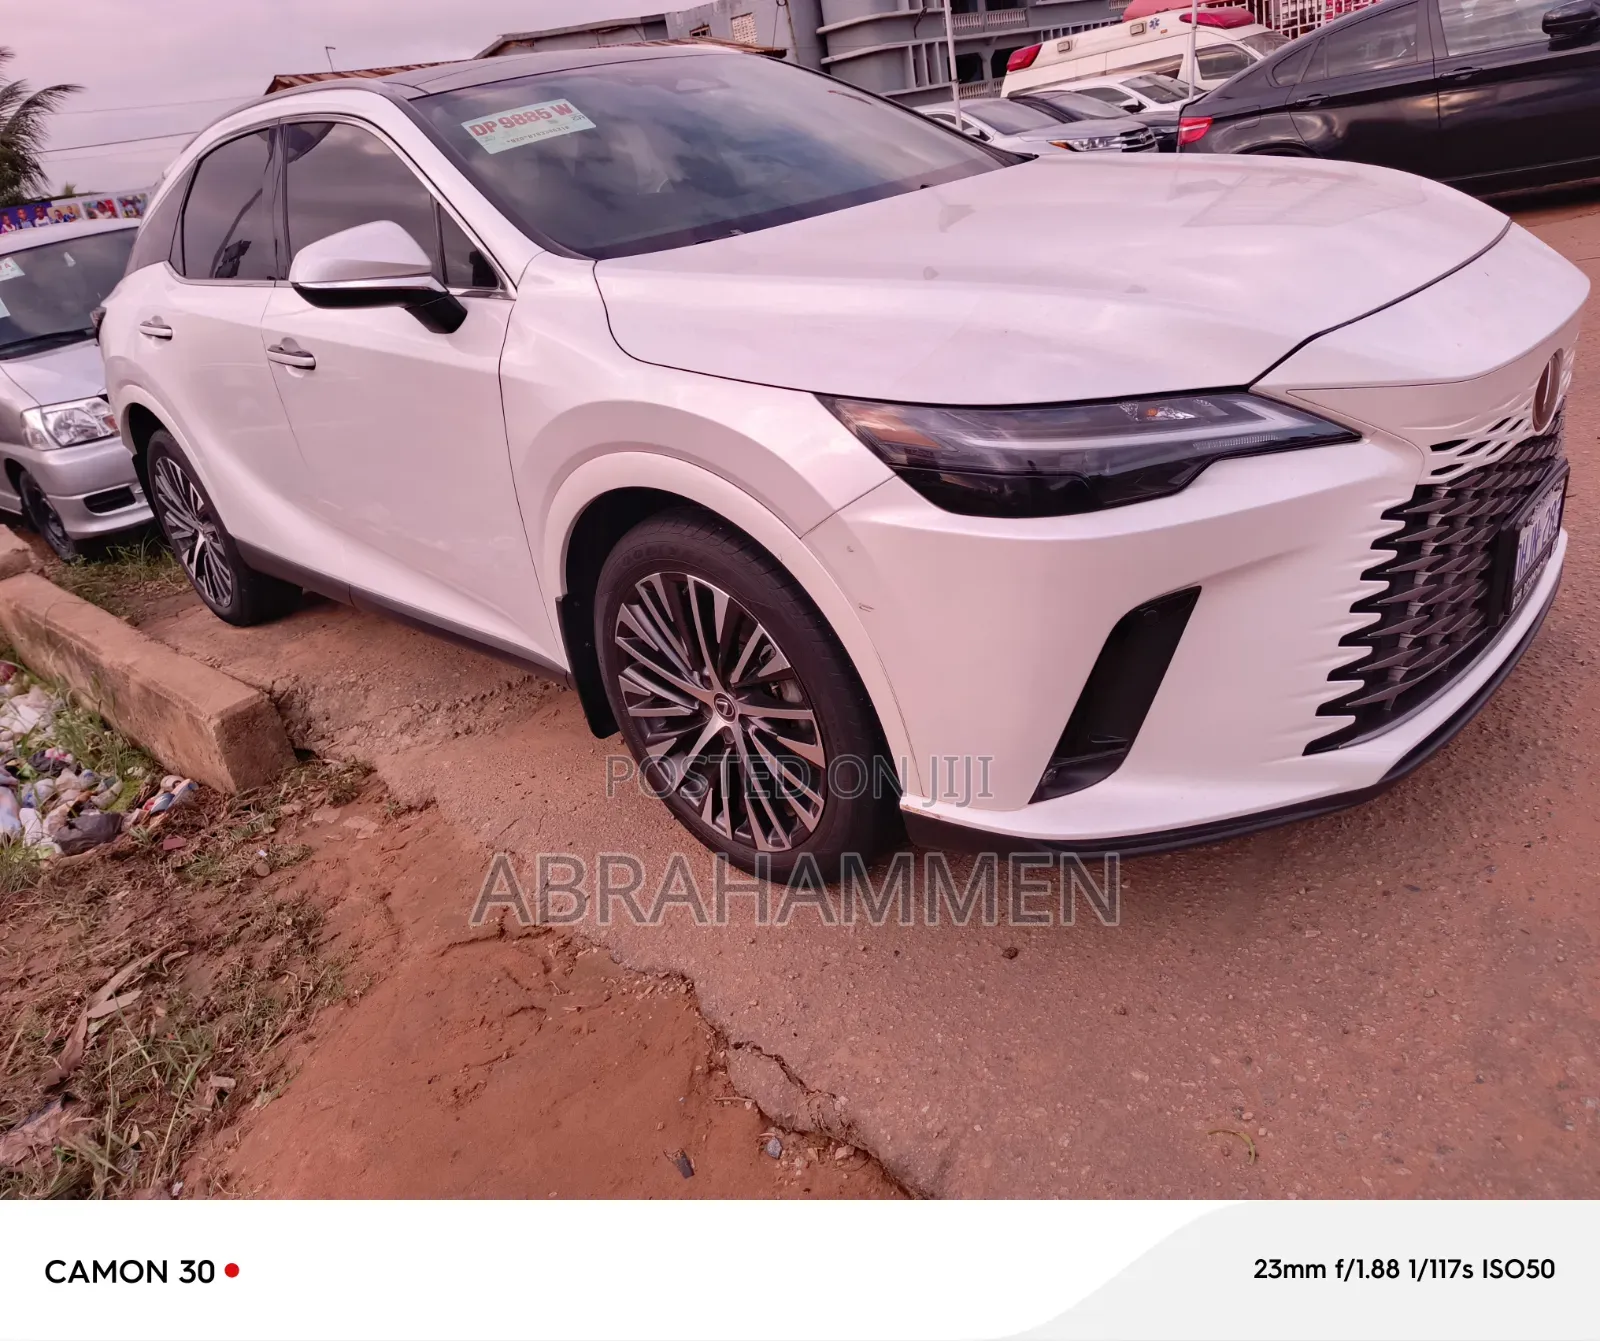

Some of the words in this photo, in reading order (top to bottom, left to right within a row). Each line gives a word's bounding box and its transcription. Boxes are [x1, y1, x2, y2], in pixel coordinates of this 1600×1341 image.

[469, 120, 497, 137] DP
[498, 107, 553, 129] 9885
[550, 103, 574, 116] W
